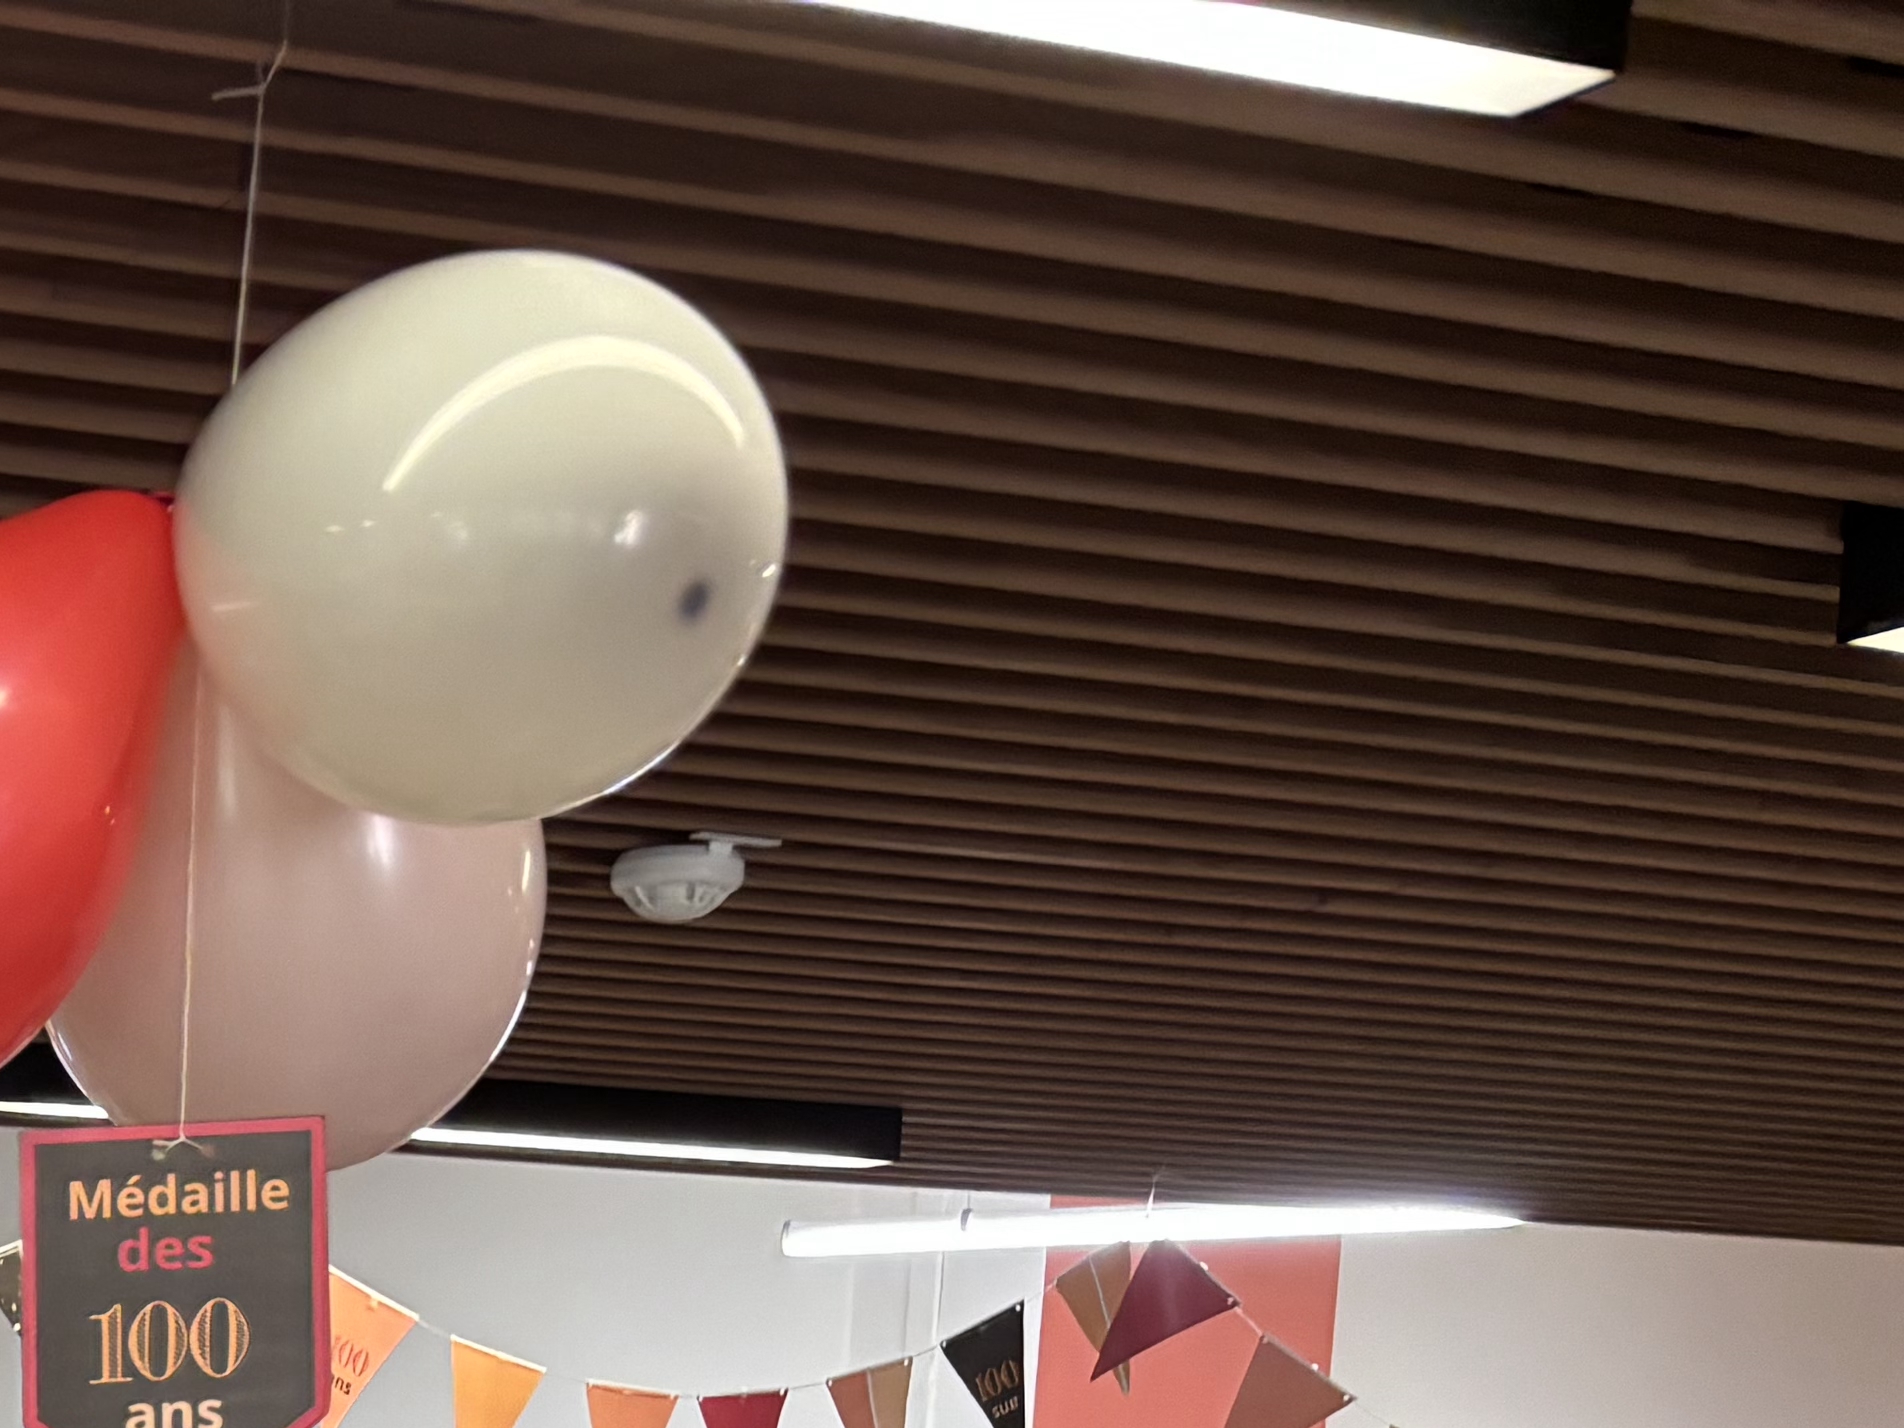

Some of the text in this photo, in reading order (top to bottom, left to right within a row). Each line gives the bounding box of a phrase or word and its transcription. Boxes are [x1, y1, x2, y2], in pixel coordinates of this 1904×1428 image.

[69, 1168, 291, 1222] Médaille
[117, 1227, 215, 1273] des
[88, 1297, 250, 1385] 100
[331, 1374, 352, 1396] ns
[975, 1358, 1019, 1402] 100
